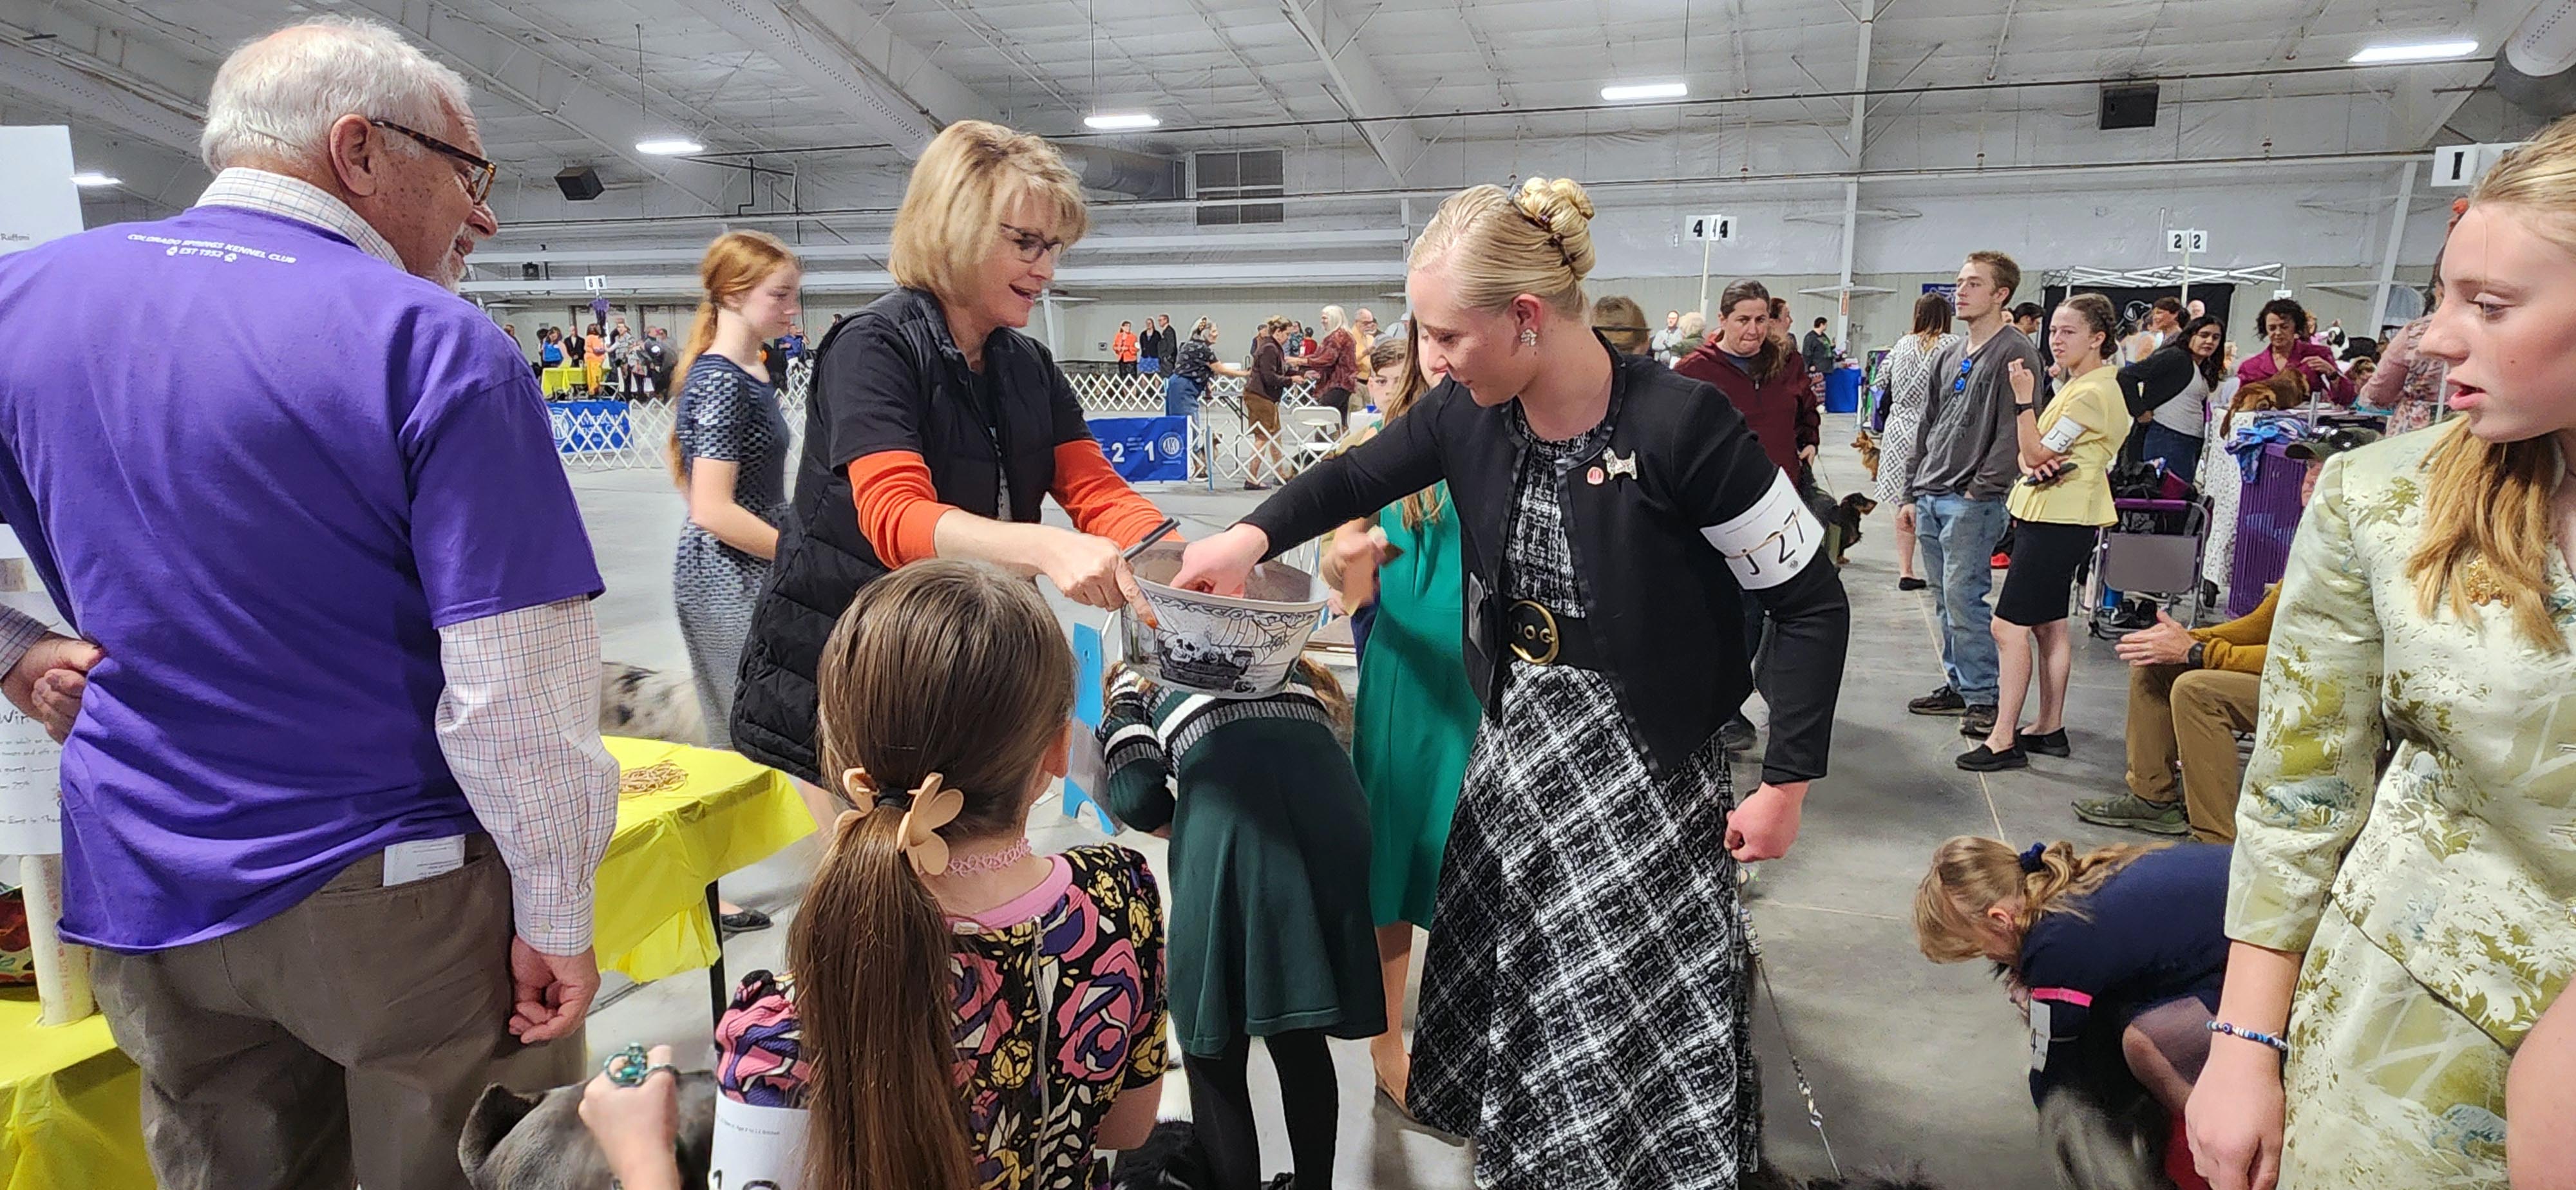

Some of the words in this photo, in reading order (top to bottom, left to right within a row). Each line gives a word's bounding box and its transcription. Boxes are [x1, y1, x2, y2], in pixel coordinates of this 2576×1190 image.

[1692, 220, 1703, 238] 4
[1719, 220, 1728, 238] 4
[128, 234, 182, 245] COLORADO
[181, 239, 225, 250] SPRINGS
[224, 243, 266, 259] KENNEL
[267, 252, 297, 263] CLUB
[2174, 233, 2182, 249] 2
[2193, 234, 2201, 249] 2
[1111, 442, 1125, 462] 2
[1144, 440, 1155, 461] 1
